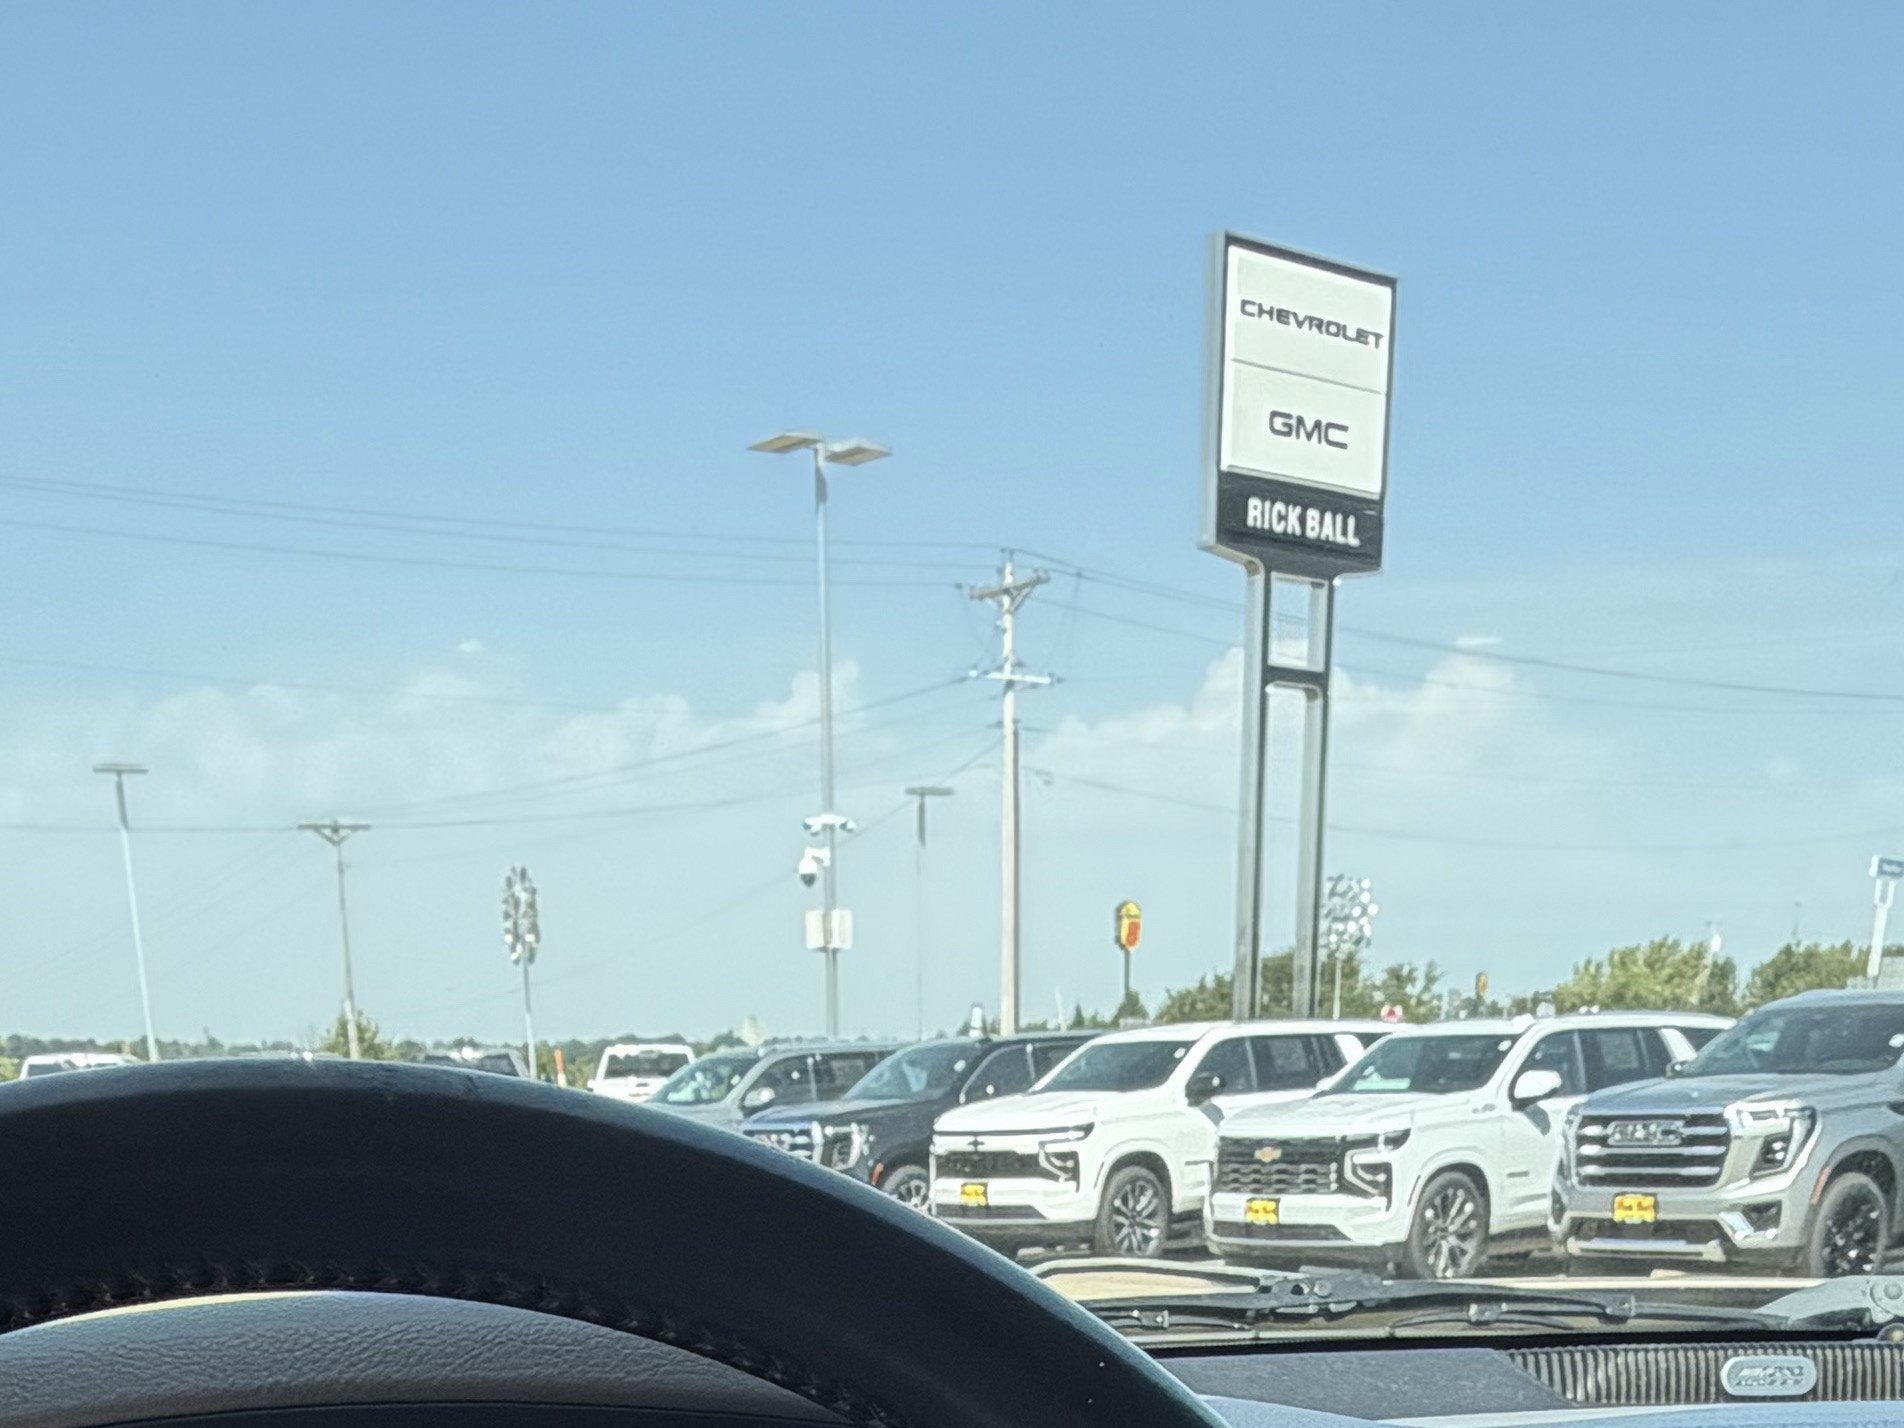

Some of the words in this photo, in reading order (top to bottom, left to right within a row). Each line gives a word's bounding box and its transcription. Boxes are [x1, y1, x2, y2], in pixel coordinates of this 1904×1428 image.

[1240, 298, 1384, 349] CHEVROLET
[1269, 410, 1348, 449] GMC
[1246, 497, 1303, 536] RICK
[1305, 508, 1360, 547] BALL
